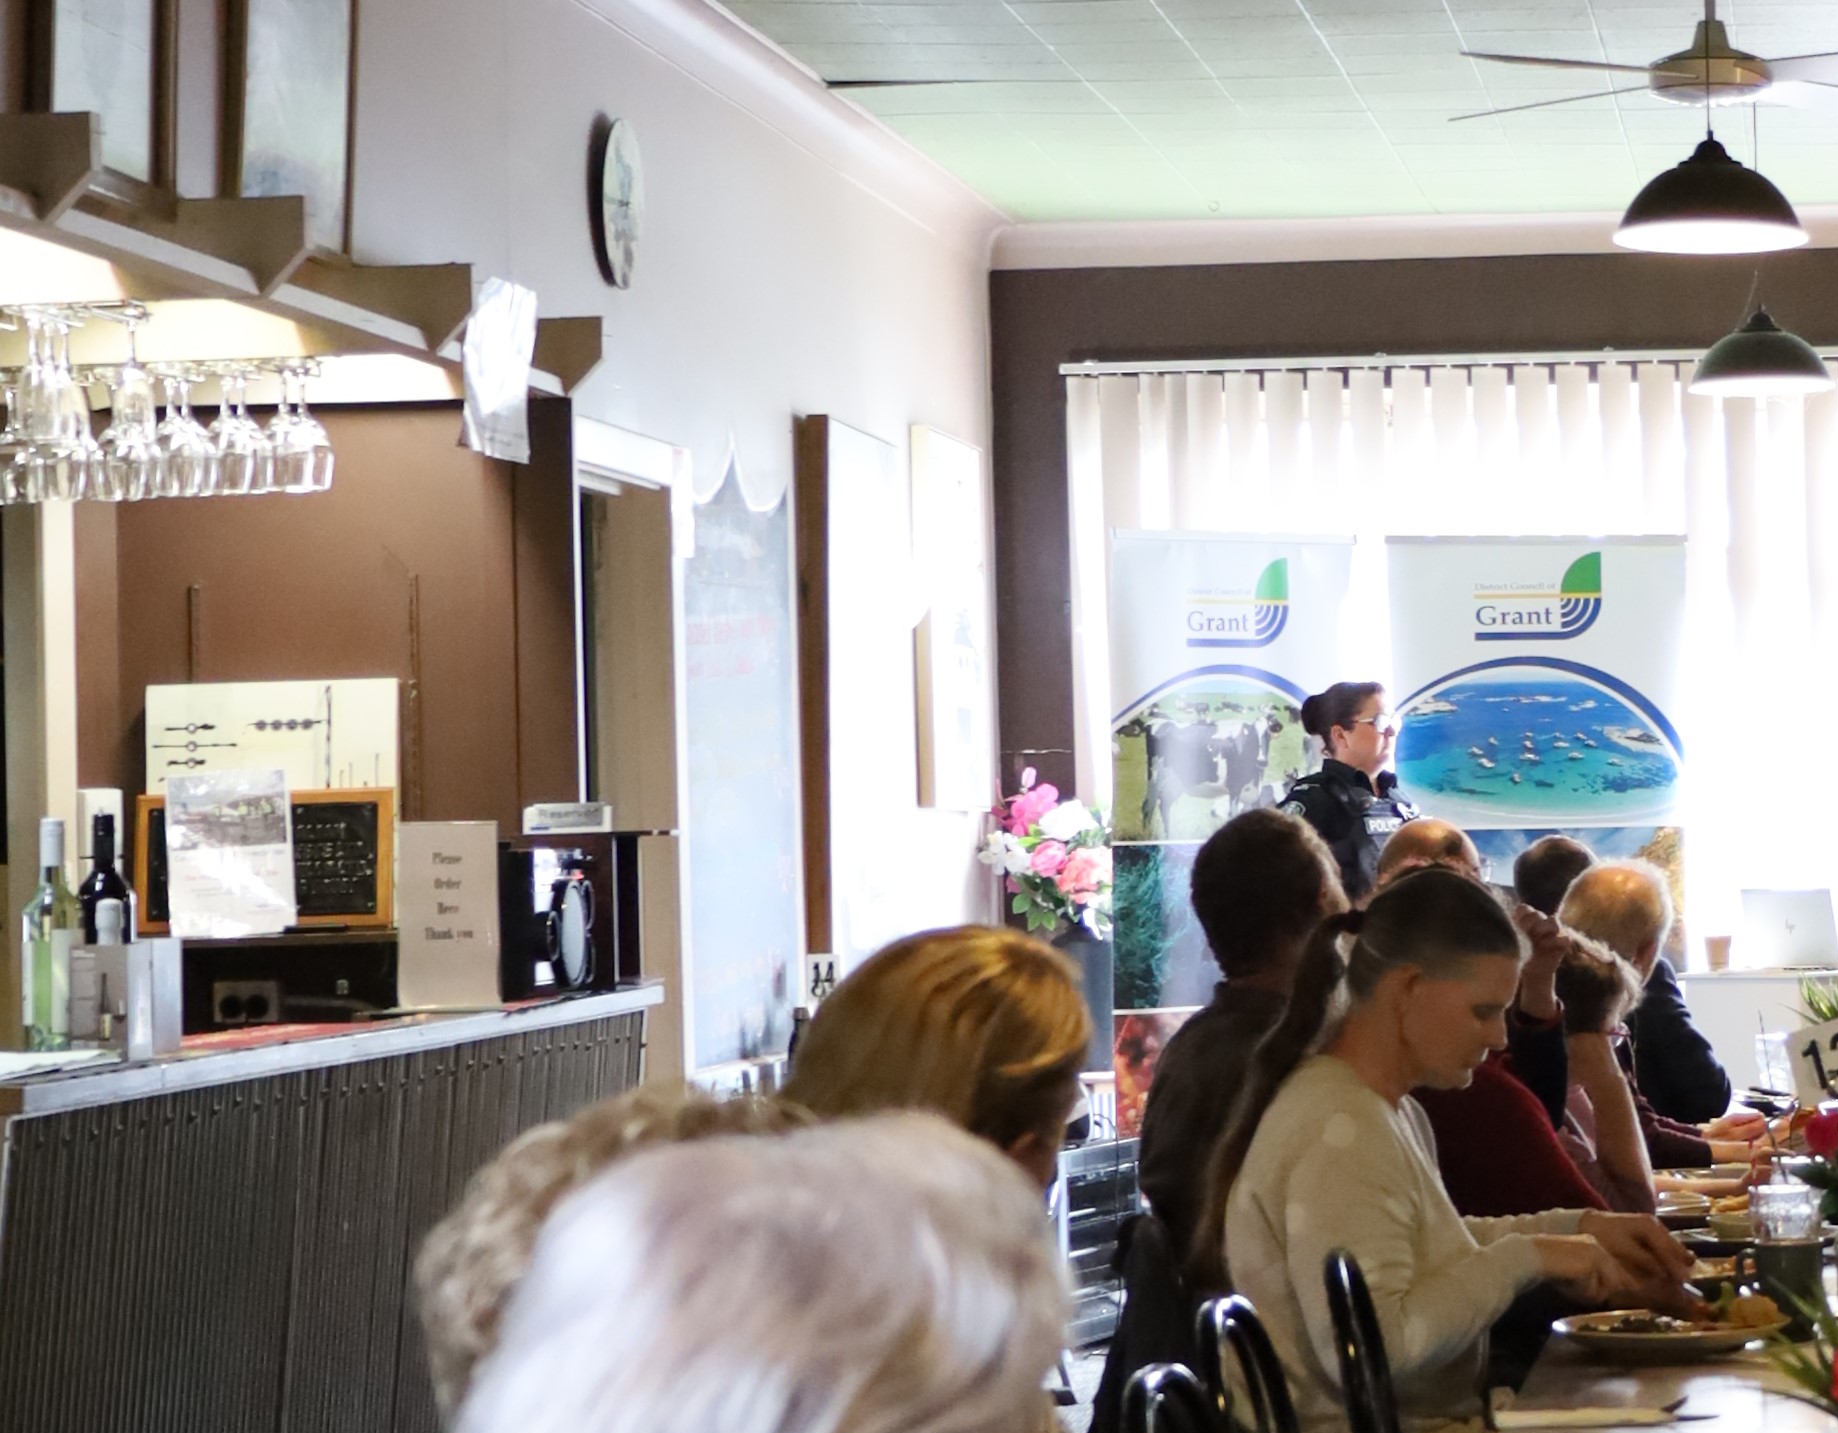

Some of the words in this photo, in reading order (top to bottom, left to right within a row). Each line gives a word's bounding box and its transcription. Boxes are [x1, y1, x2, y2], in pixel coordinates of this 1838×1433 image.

[1510, 582, 1544, 591] Council
[1546, 582, 1556, 590] of
[1187, 610, 1248, 632] Grant
[1475, 605, 1553, 626] Grant
[432, 852, 462, 865] Please
[433, 878, 462, 890] Order
[437, 902, 459, 915] Here
[425, 927, 454, 940] Thank
[456, 929, 473, 942] you
[812, 961, 836, 989] 14
